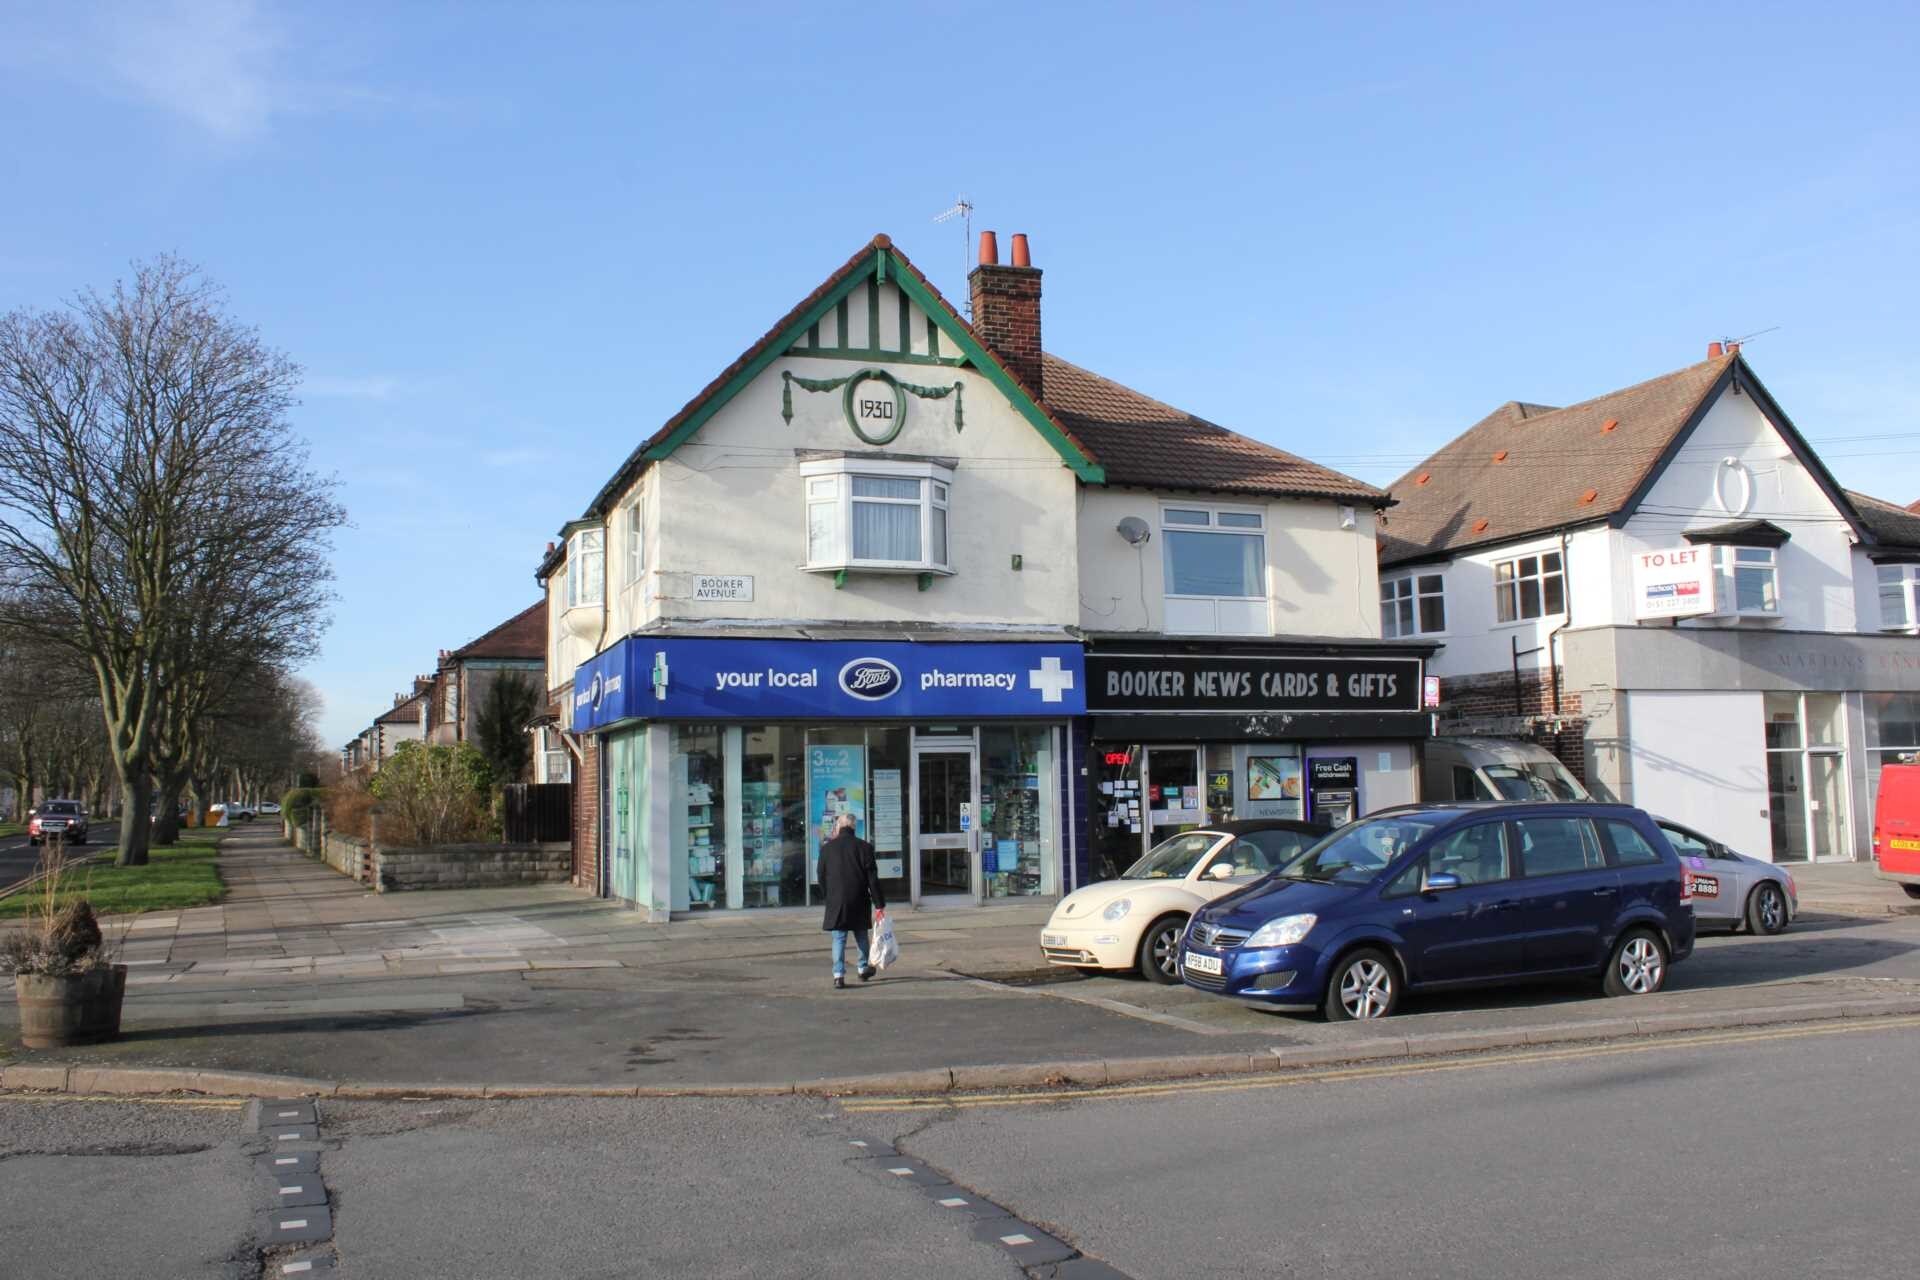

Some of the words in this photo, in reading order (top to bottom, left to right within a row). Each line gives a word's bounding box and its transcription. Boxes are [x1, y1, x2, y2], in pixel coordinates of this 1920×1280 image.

[860, 399, 893, 419] 1930
[1641, 554, 1665, 568] TO
[1670, 550, 1699, 565] LET
[701, 578, 744, 589] BOOKER
[696, 588, 737, 599] AVENUE
[1778, 654, 1865, 671] MARTINS
[716, 670, 763, 691] your
[768, 668, 818, 688] local
[850, 667, 891, 690] Boots
[920, 668, 1017, 692] pharmacy
[1106, 671, 1185, 697] BOOKER
[1194, 671, 1251, 697] NEWS
[1260, 672, 1318, 697] CARDS
[1326, 673, 1339, 698] &
[1348, 673, 1397, 698] GIFTS
[813, 750, 825, 767] 3
[837, 750, 849, 767] 2
[1105, 752, 1131, 765] OPEN
[1315, 763, 1332, 772] Free
[1333, 763, 1352, 772] Cash
